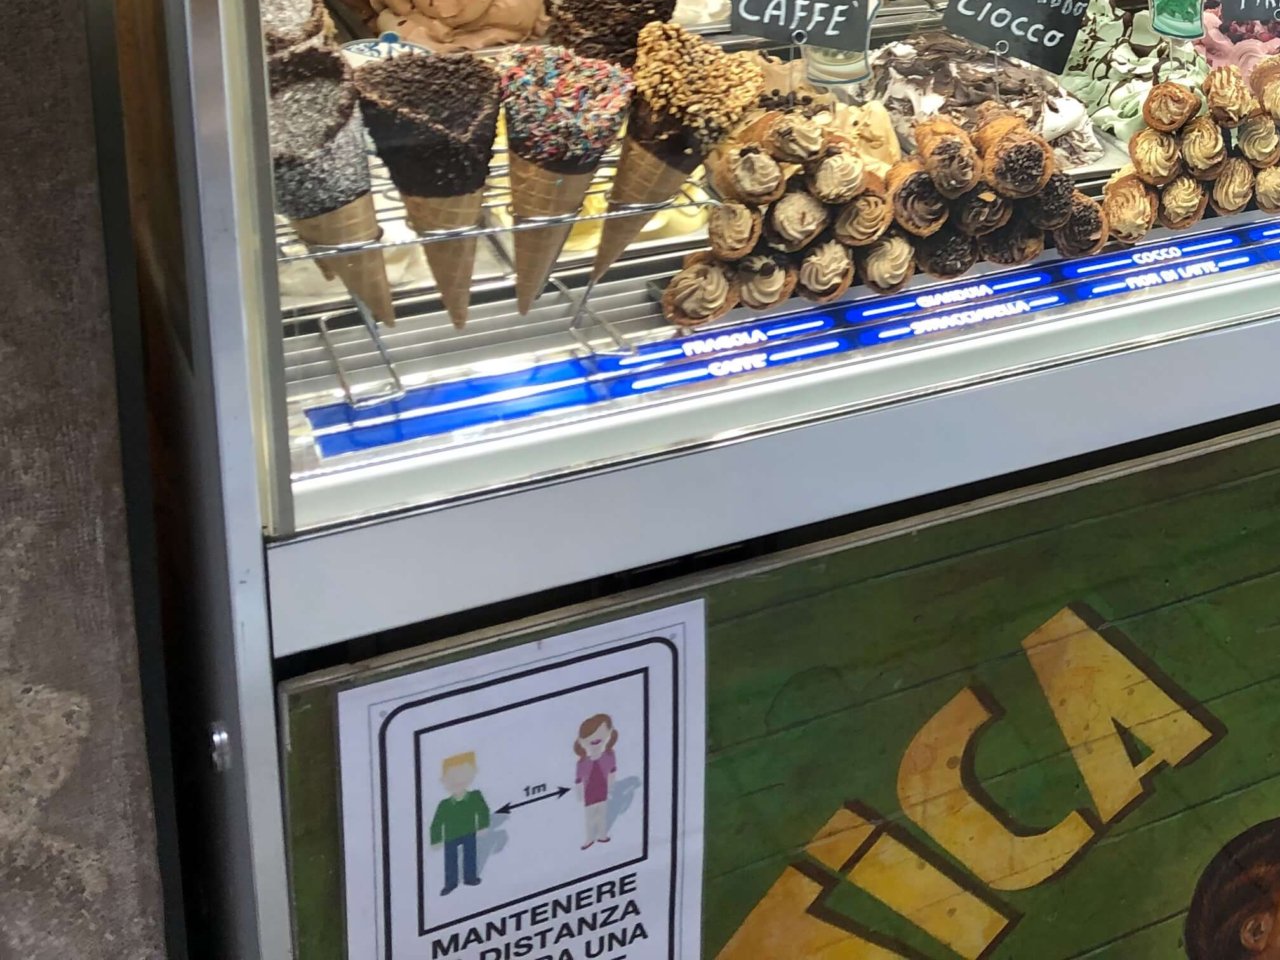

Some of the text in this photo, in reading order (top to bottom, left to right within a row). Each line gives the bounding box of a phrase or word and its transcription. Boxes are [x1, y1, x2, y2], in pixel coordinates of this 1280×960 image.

[1131, 246, 1183, 264] COCCO
[523, 783, 548, 798] 1m
[431, 872, 638, 960] MANTENERE
[480, 899, 641, 960] DISTANZA
[585, 922, 649, 959] UNA
